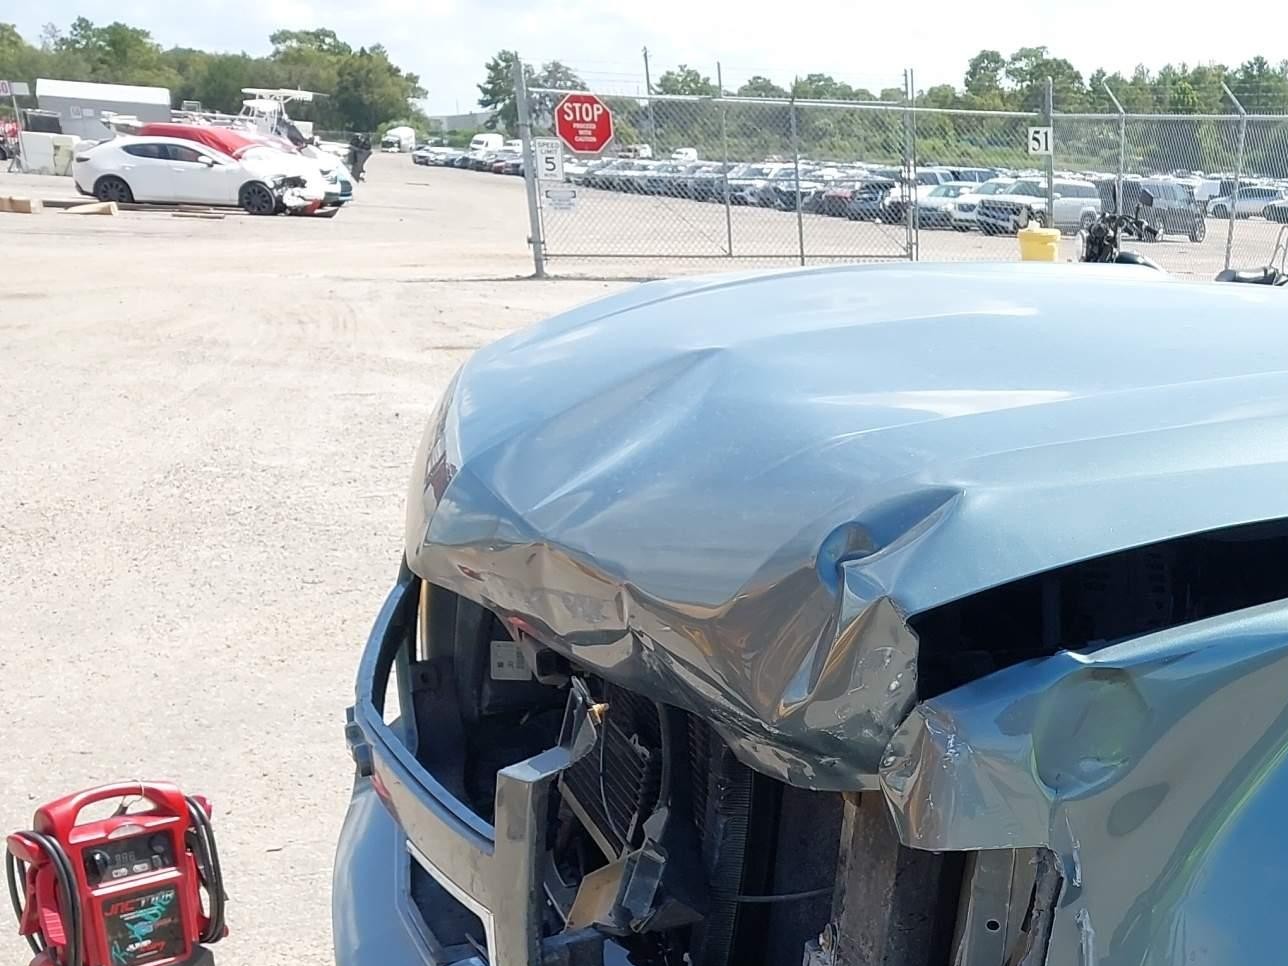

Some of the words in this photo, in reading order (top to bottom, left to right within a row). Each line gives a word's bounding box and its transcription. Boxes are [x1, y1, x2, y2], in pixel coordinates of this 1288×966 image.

[563, 102, 604, 122] STOP
[537, 141, 560, 149] SPEED
[1031, 130, 1049, 152] 51
[545, 156, 557, 172] 5
